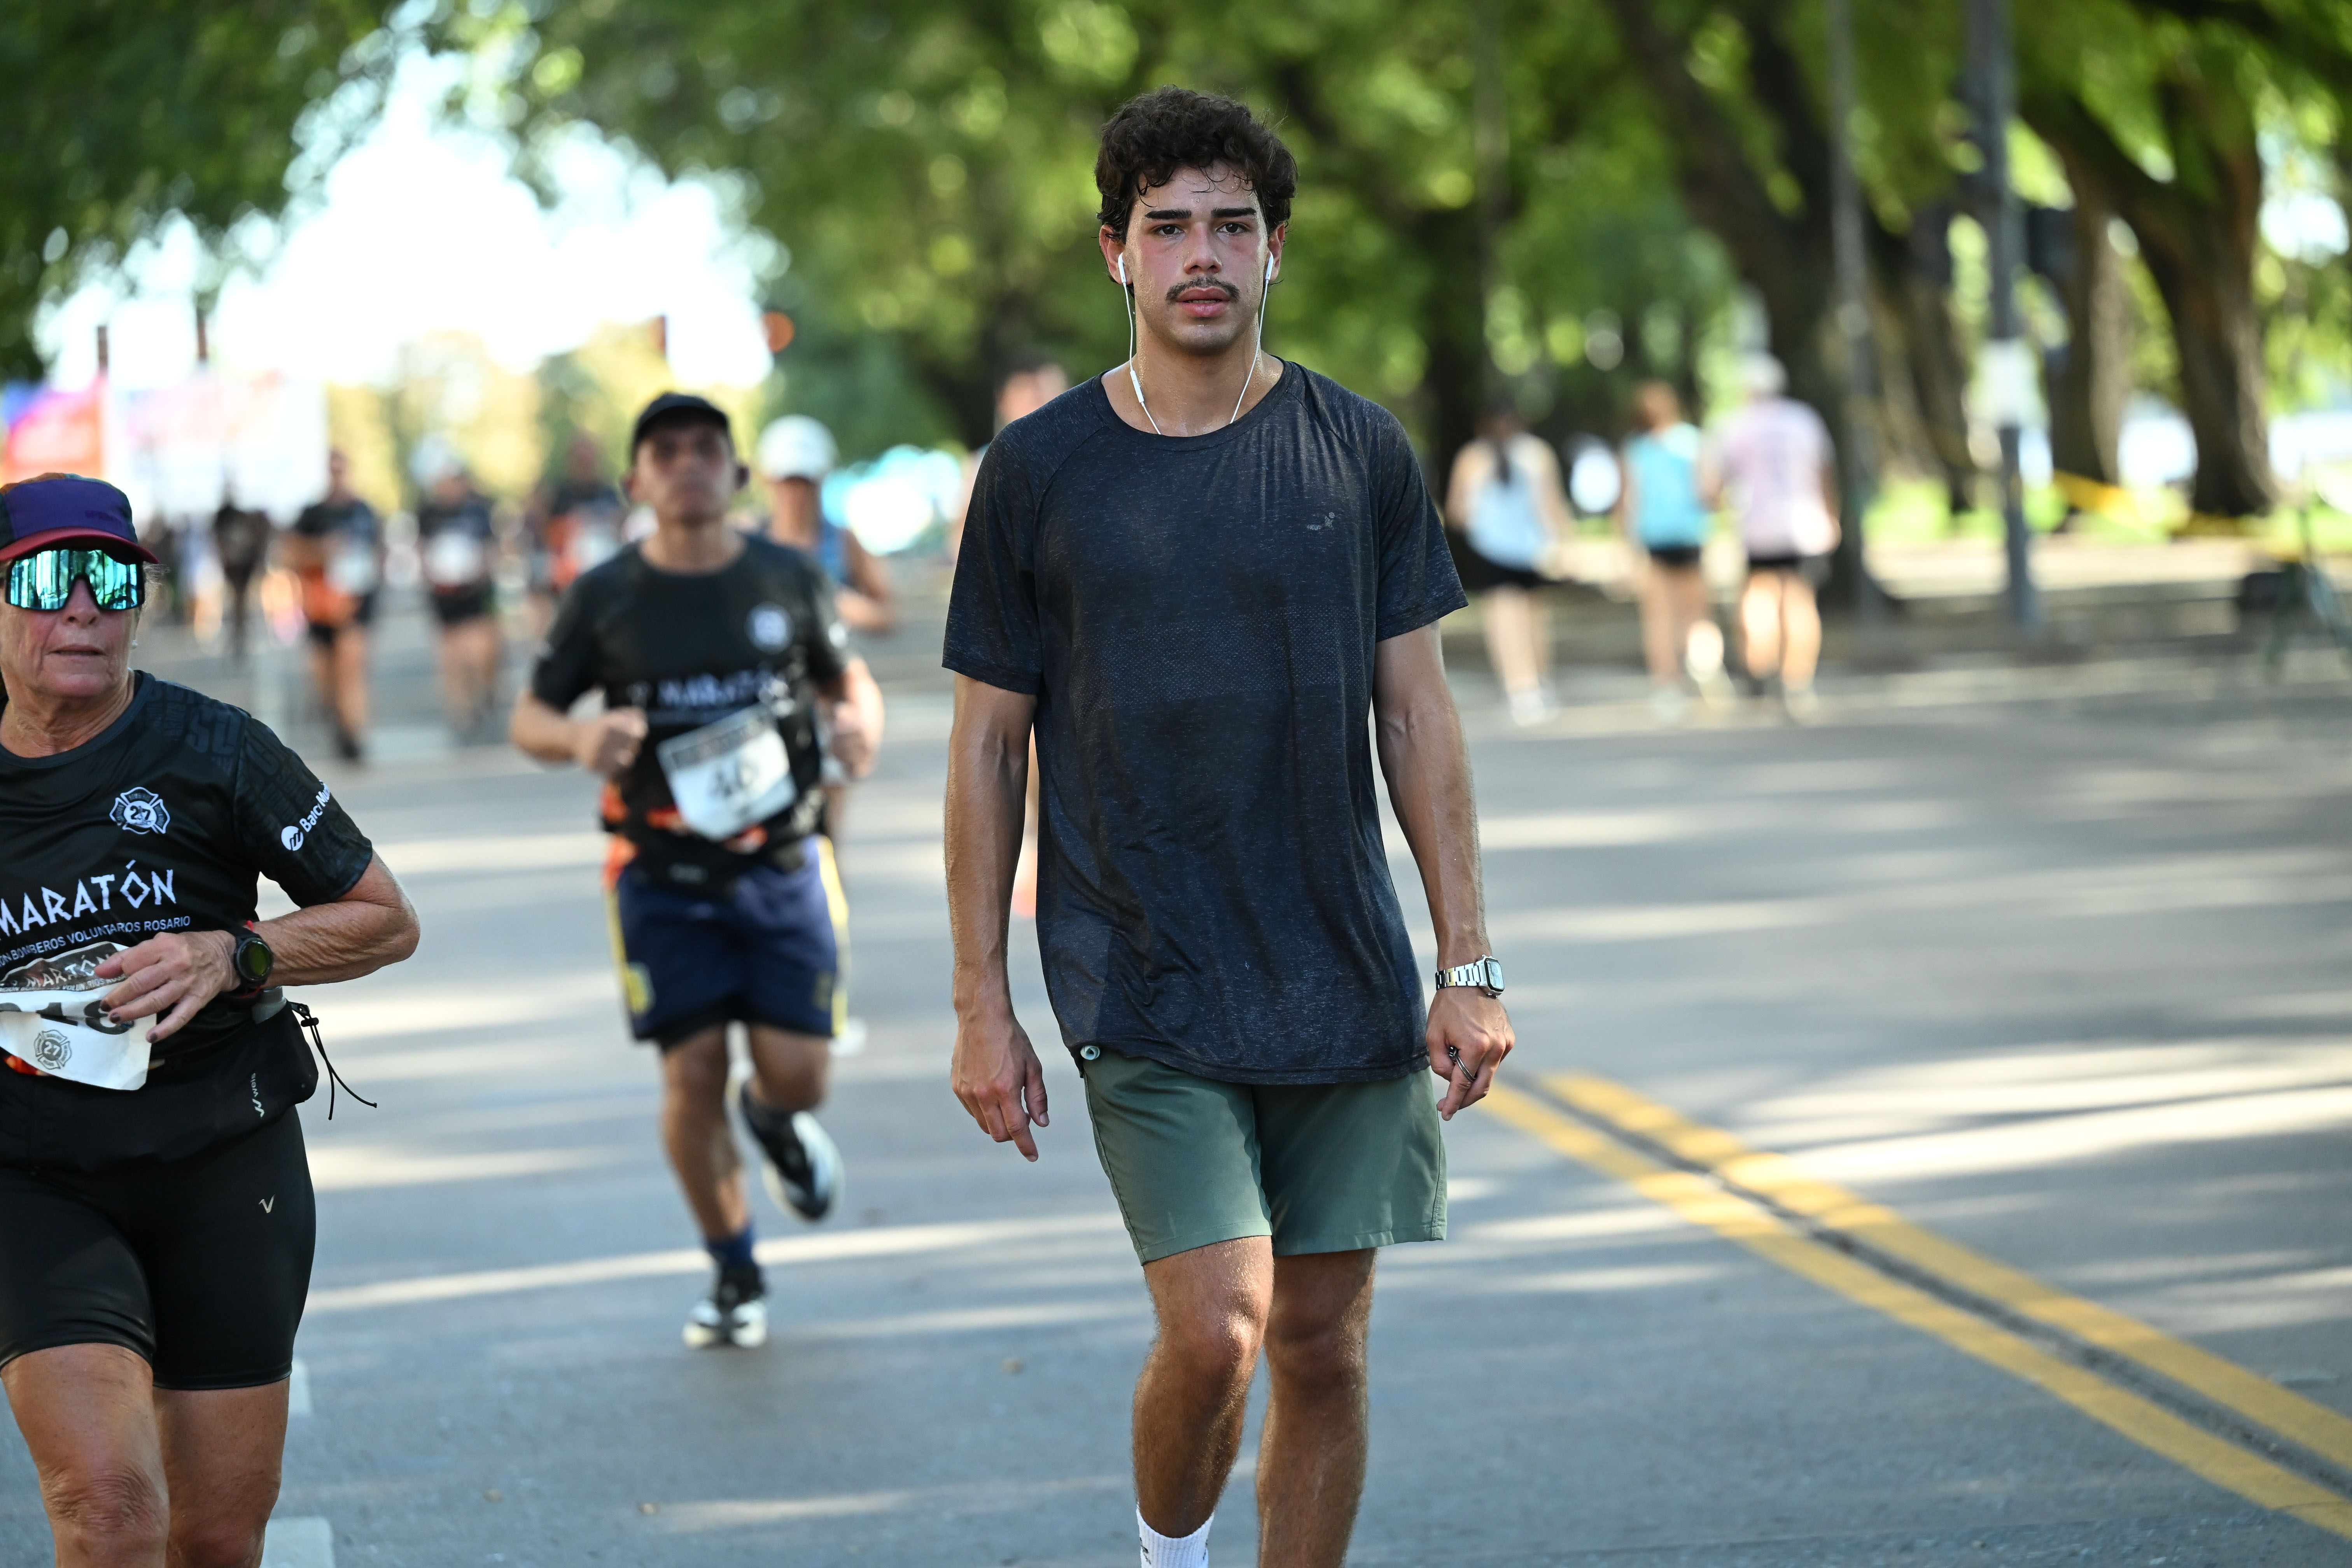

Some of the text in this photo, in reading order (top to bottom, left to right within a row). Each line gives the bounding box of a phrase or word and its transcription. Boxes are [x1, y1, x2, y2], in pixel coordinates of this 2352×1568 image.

[130, 805, 150, 820] 27
[0, 859, 177, 940] MARATÓN
[10, 936, 66, 961] BOMBEROS
[144, 916, 191, 931] ROSARIO
[44, 1041, 61, 1055] 27
